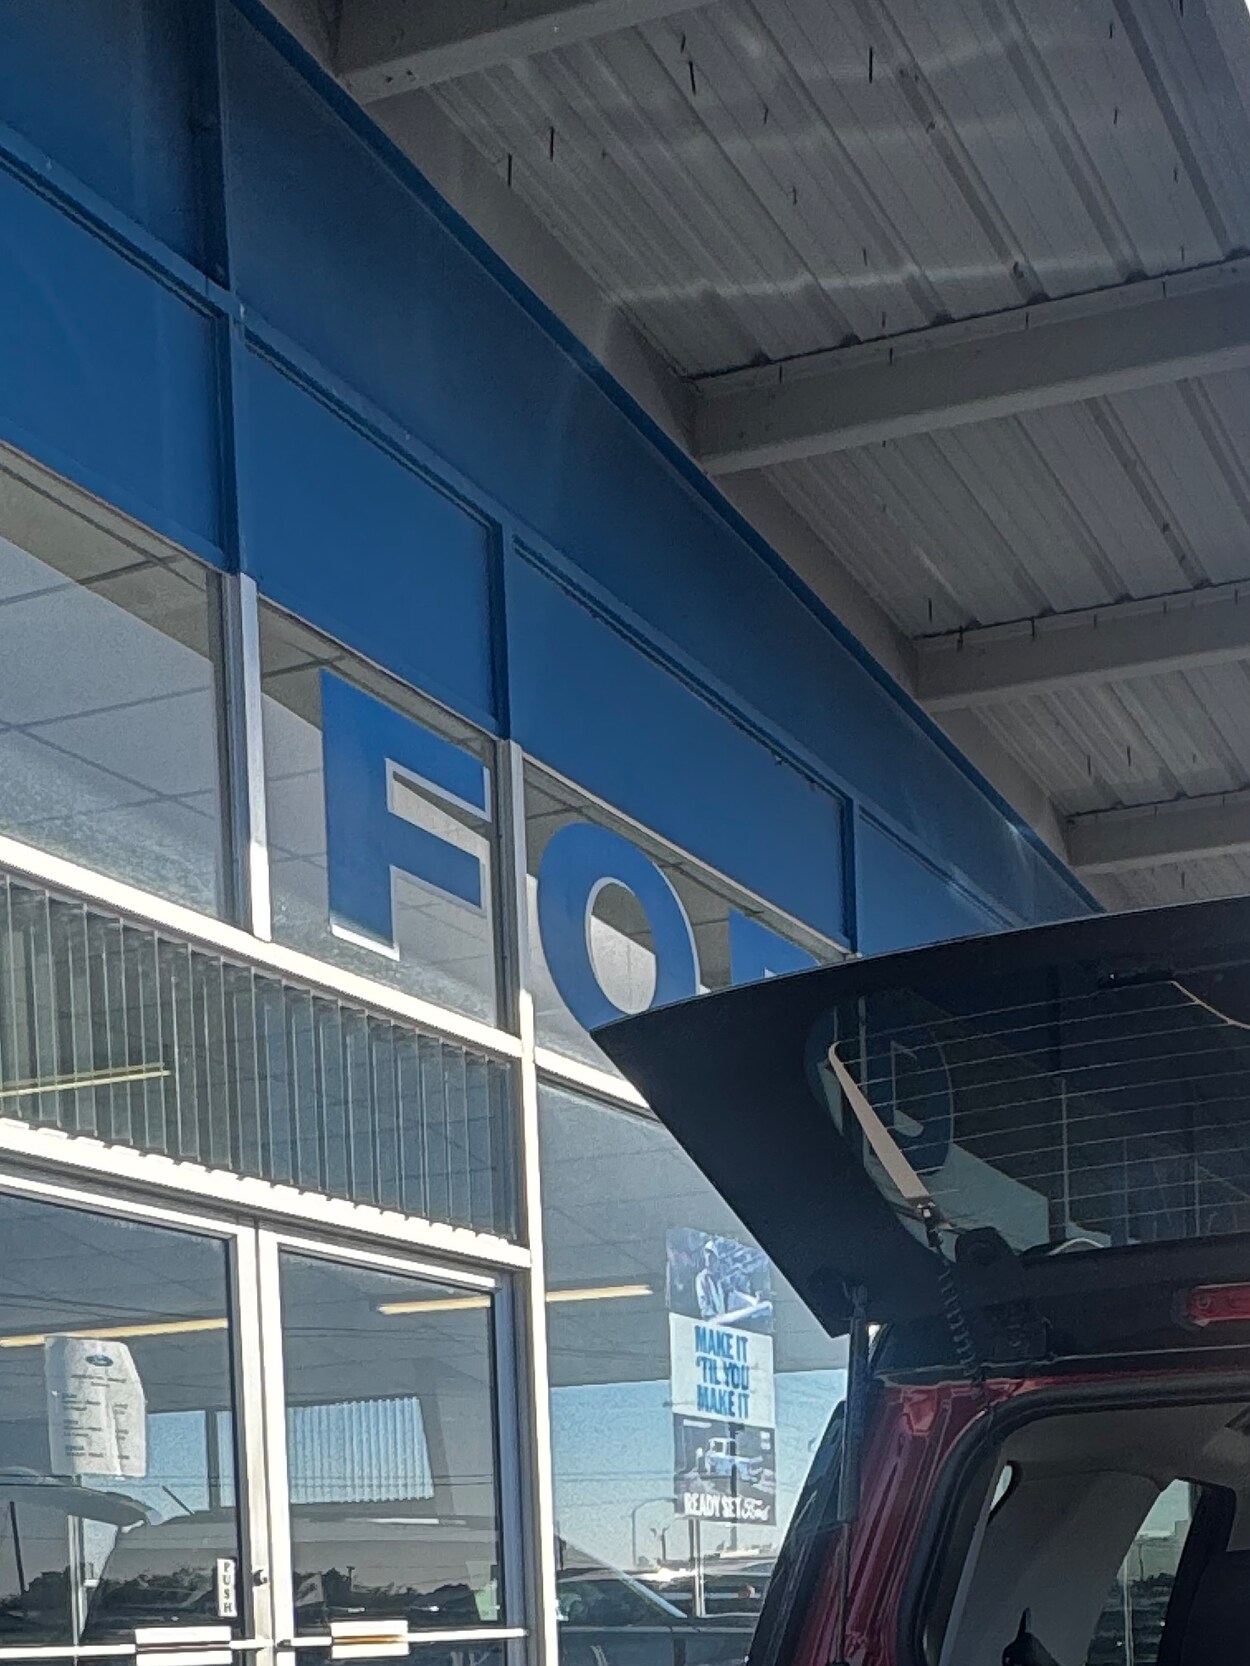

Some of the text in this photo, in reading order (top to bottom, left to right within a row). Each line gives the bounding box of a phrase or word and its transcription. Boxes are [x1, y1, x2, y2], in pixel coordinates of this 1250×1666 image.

[695, 1325, 749, 1363] MAKE IT
[696, 1356, 750, 1390] 'TIL YOU
[697, 1384, 749, 1419] MAKE IT
[684, 1492, 720, 1518] READY
[721, 1496, 742, 1519] SET
[222, 1561, 233, 1614] PUSH
